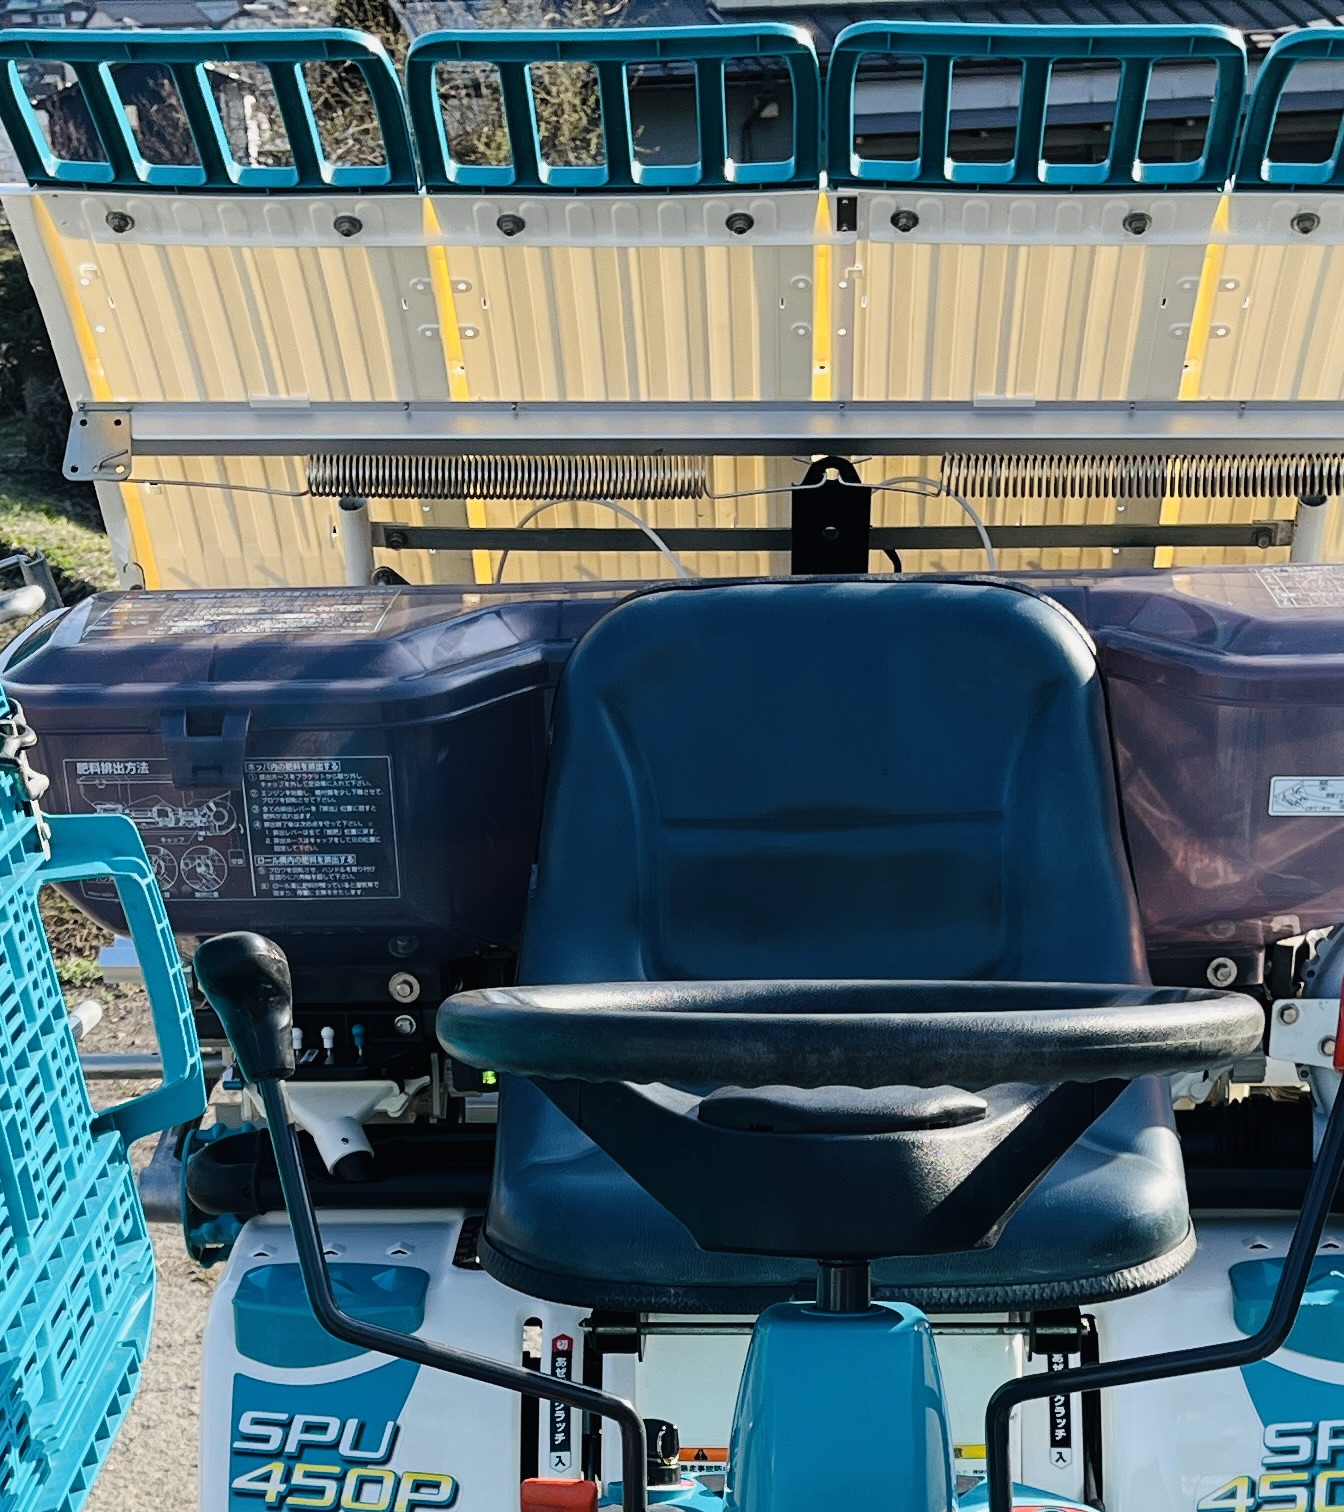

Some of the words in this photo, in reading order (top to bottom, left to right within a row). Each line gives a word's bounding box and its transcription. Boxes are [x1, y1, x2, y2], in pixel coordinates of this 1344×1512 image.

[77, 762, 149, 774] 肥料排出方法
[232, 1410, 399, 1463] SPU
[554, 1455, 566, 1467] 入
[1055, 1451, 1067, 1463] 入
